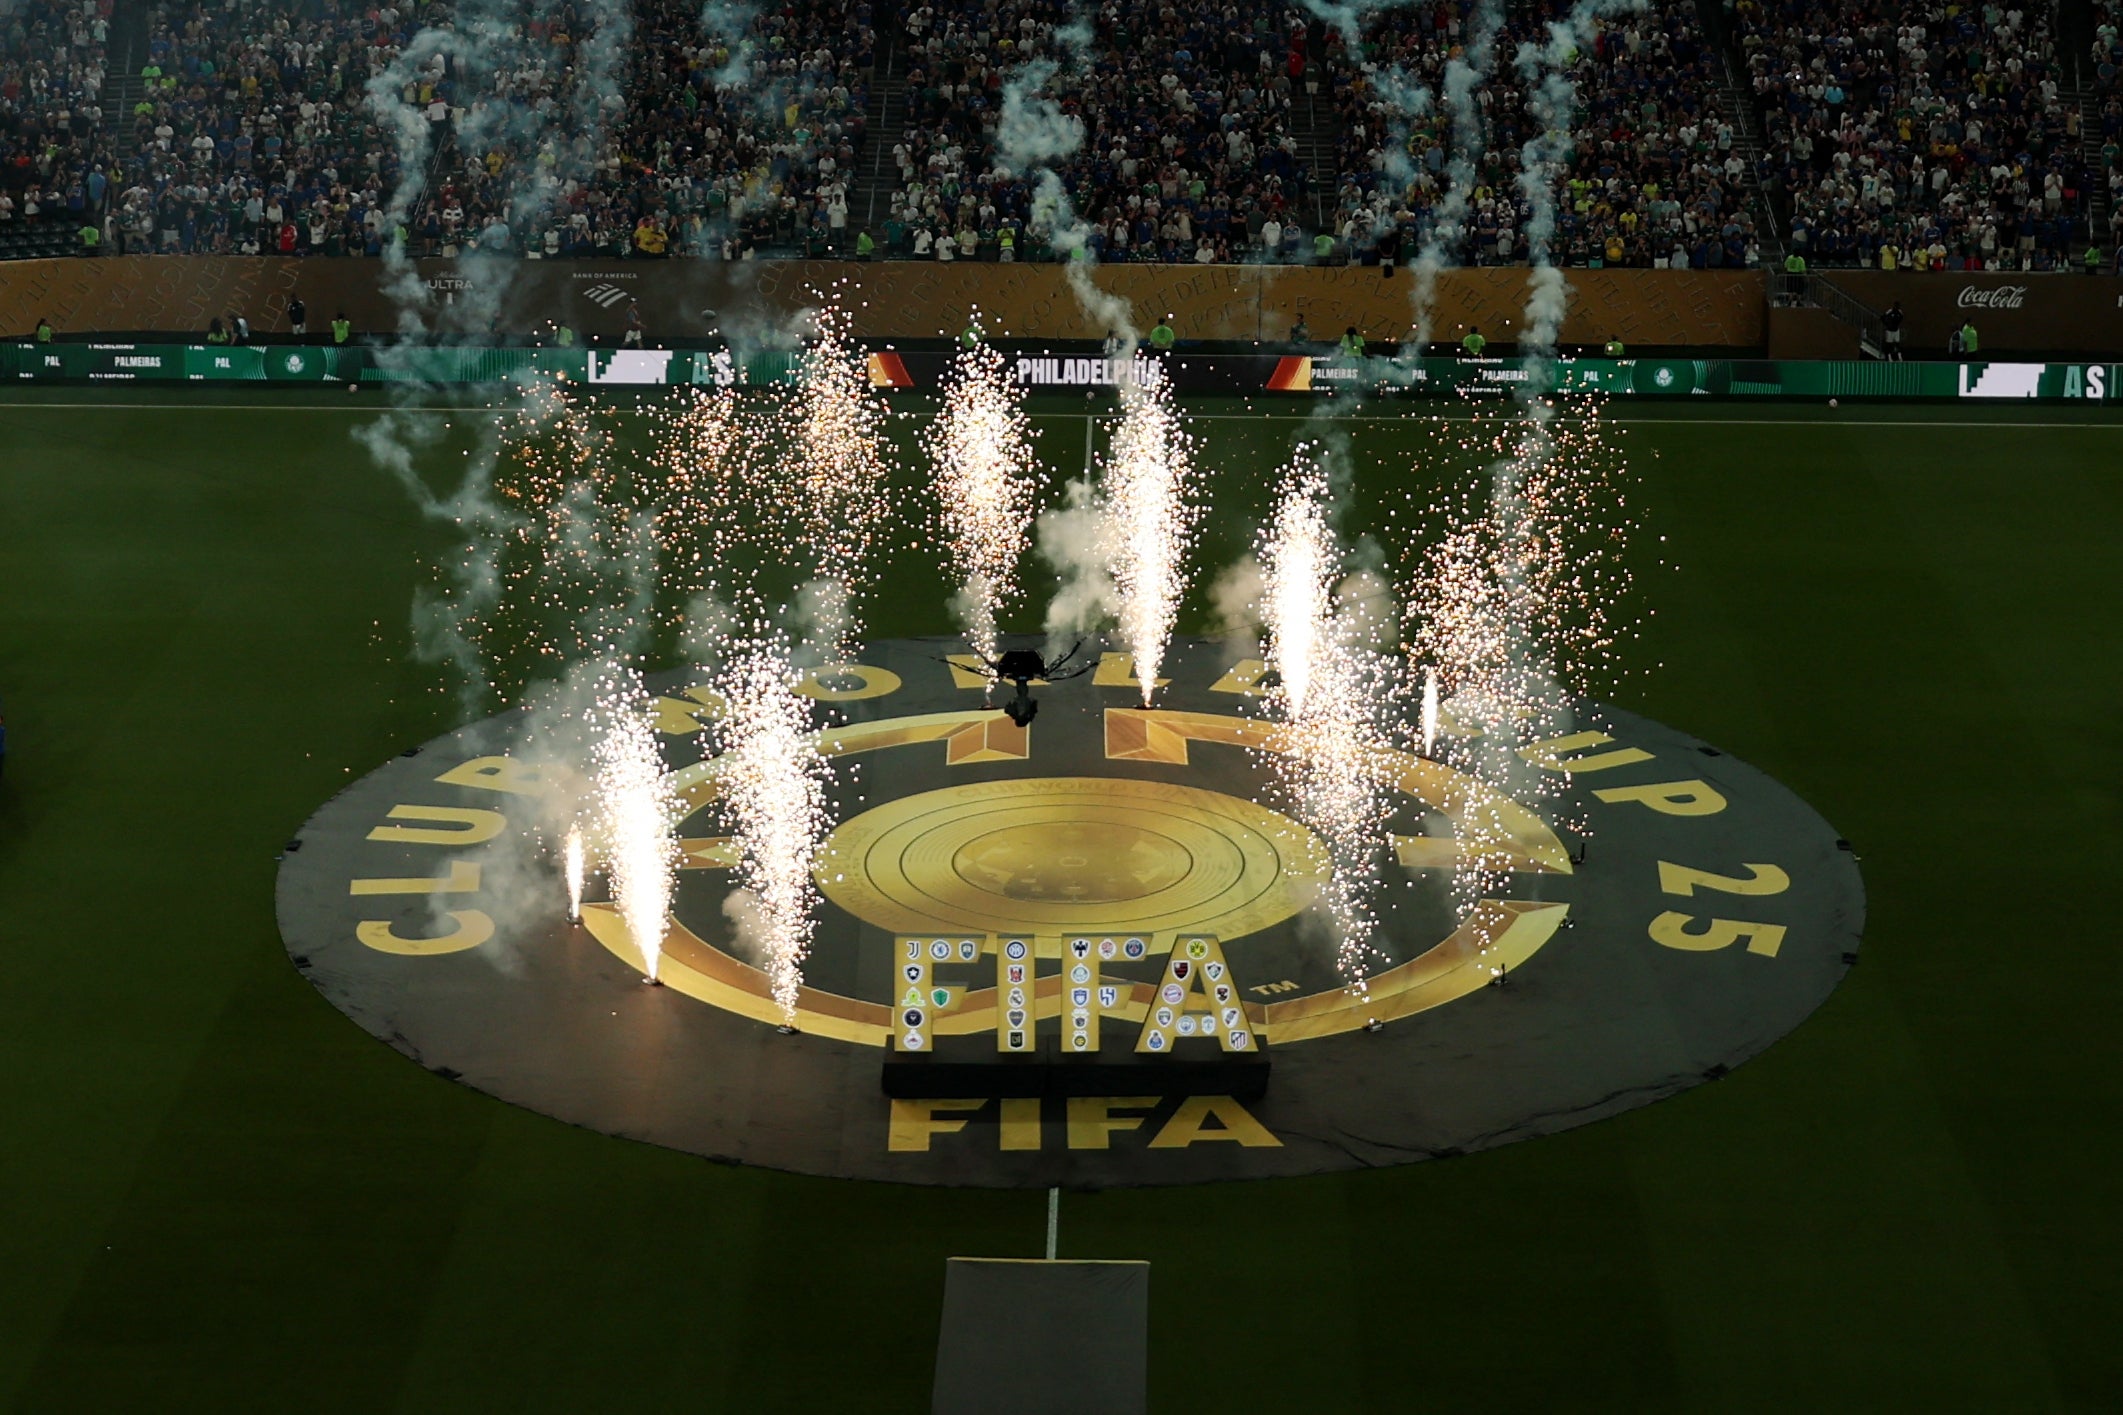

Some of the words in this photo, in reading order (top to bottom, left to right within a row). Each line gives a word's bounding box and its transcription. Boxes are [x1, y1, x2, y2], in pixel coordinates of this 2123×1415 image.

[427, 279, 474, 289] ULTRA
[44, 355, 61, 367] PAL
[114, 356, 161, 368] PALMEIRAS
[215, 357, 231, 369] PAL
[1017, 358, 1162, 385] PHILADELPHIA
[1310, 368, 1359, 380] PALMEIRAS
[1412, 369, 1428, 381] PAL
[1482, 369, 1529, 382] PALMEIRAS
[1583, 370, 1600, 382] PAL
[350, 756, 574, 956] CLUB
[1647, 859, 1791, 959] 25
[893, 932, 1260, 1053] FIFA
[1249, 980, 1300, 996] TM
[887, 1094, 1285, 1152] FIFA
